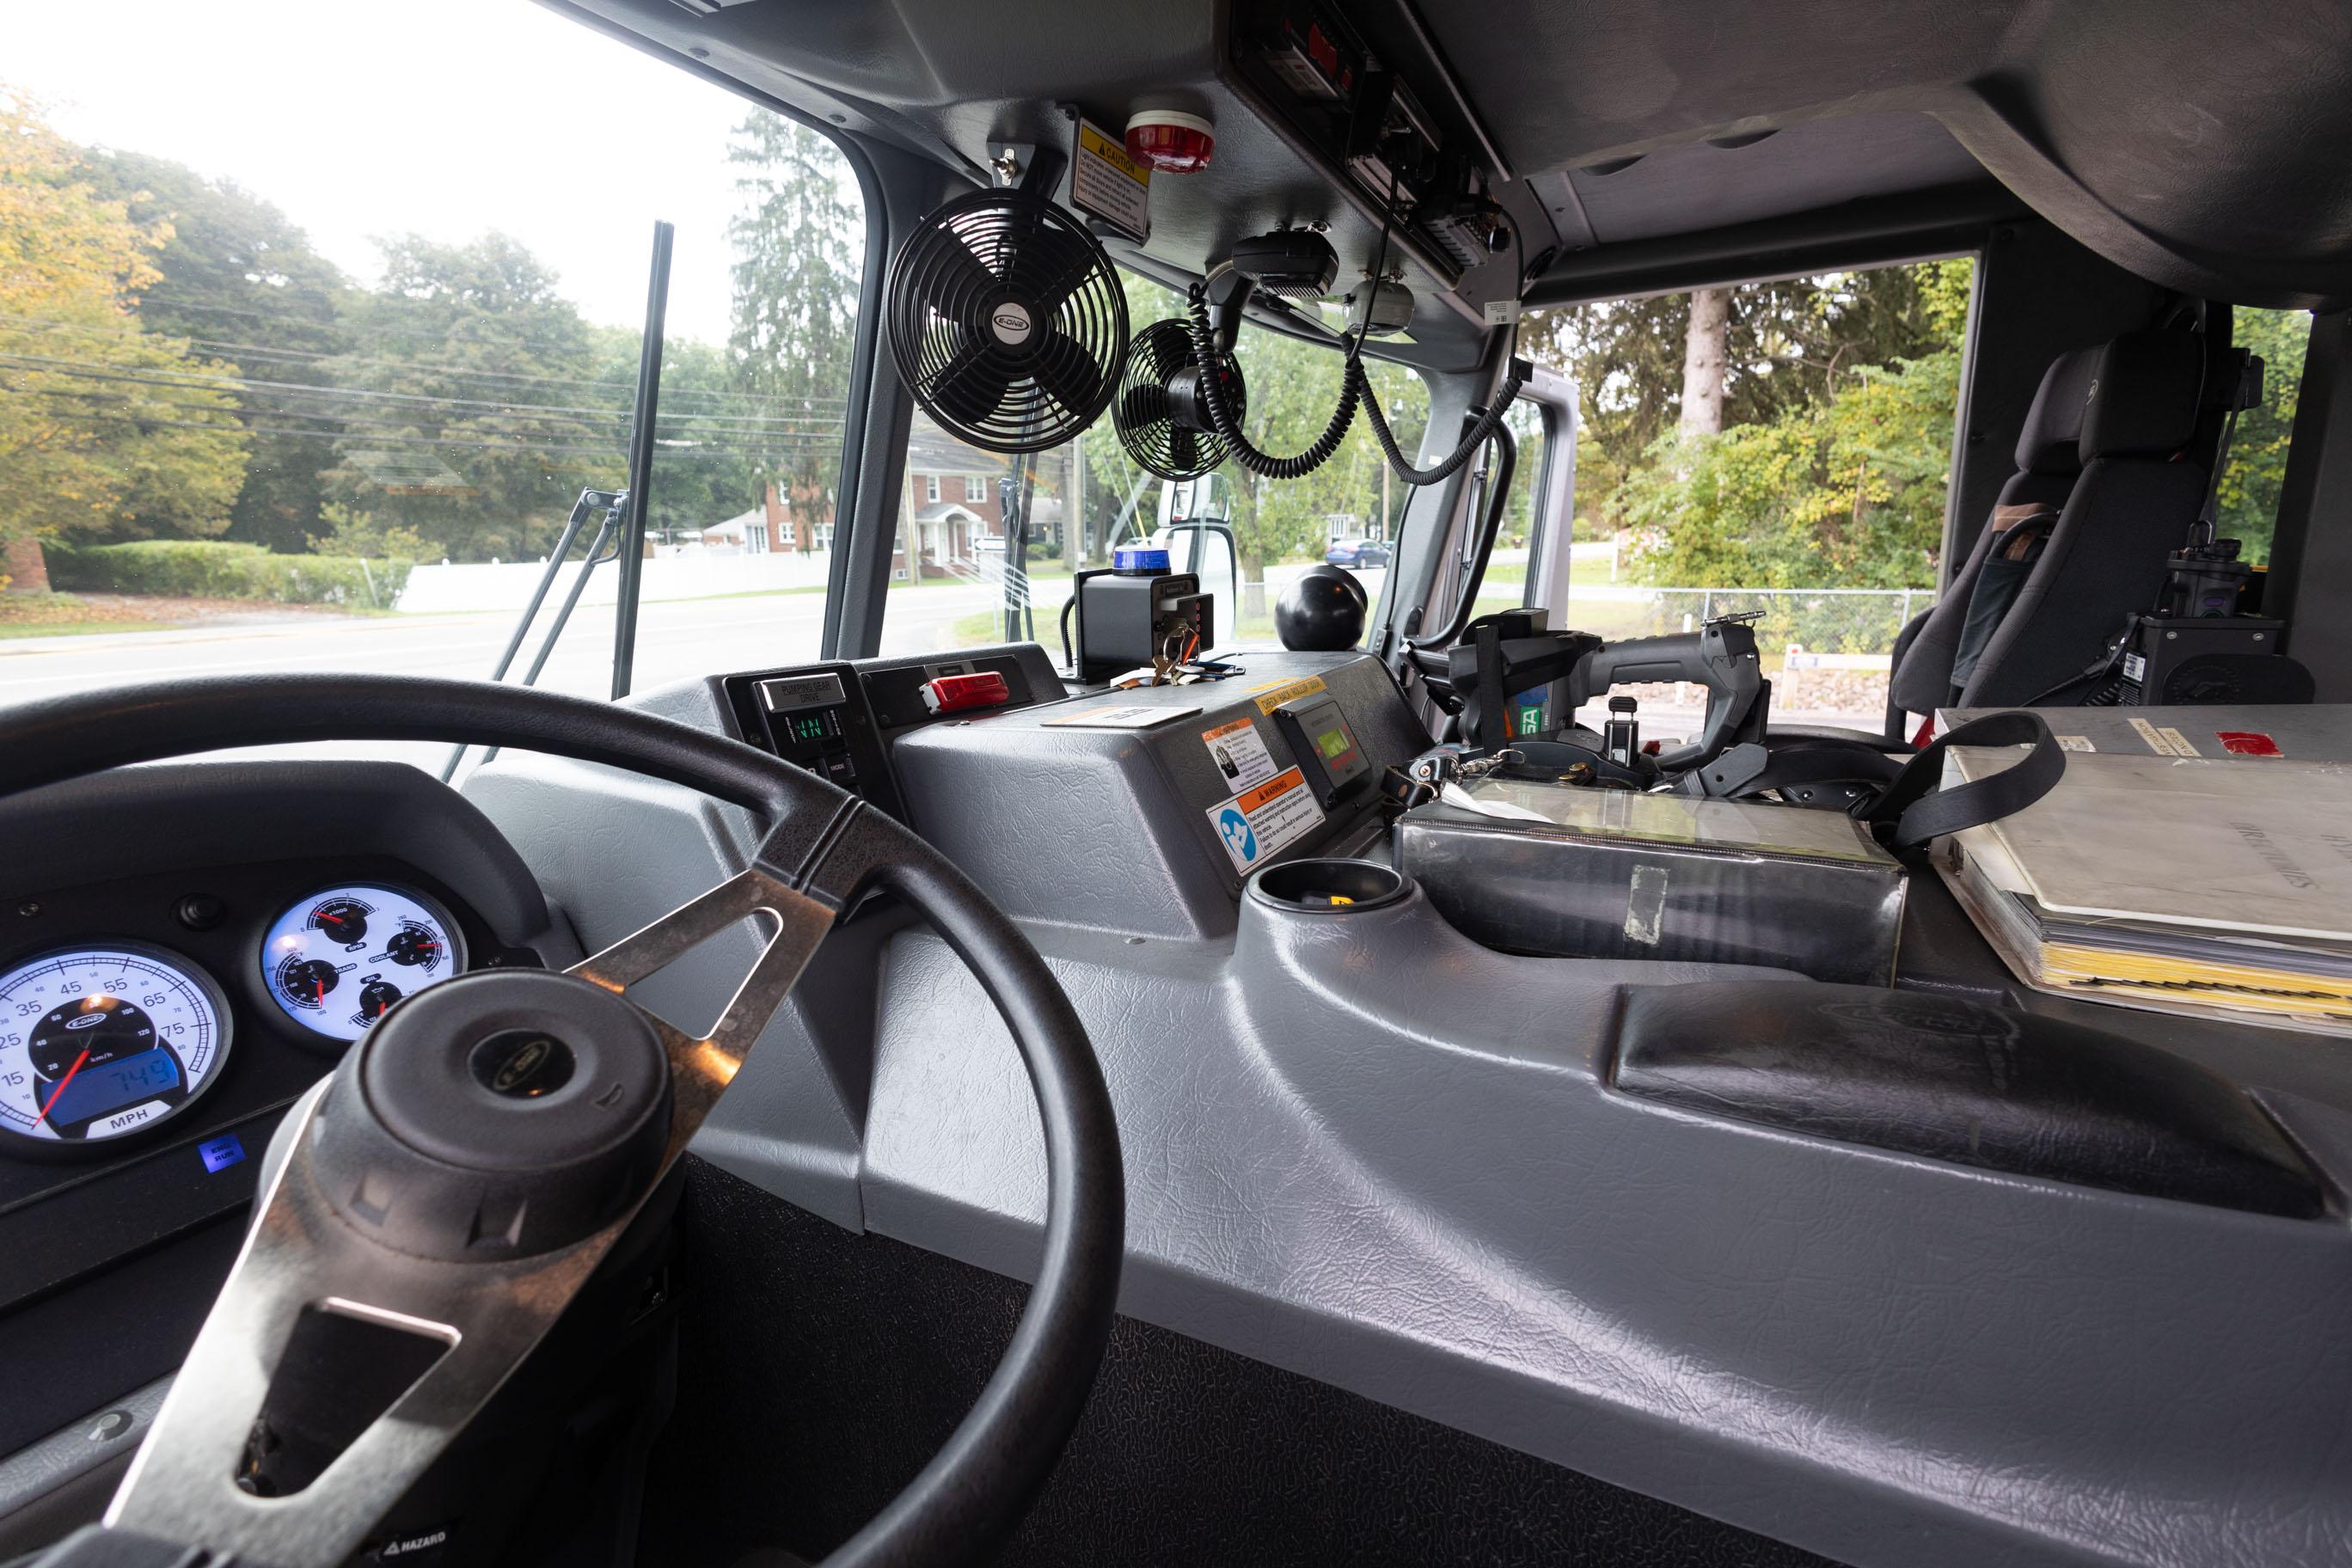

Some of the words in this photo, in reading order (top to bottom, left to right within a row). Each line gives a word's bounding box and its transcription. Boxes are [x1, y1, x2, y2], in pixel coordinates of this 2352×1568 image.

[1106, 148, 1135, 174] CAUTION
[998, 317, 1024, 328] E-ONE
[781, 683, 812, 695] PUMPING
[813, 680, 831, 691] GEAR
[800, 693, 821, 702] DRIVE
[1264, 780, 1288, 798] WARNING
[349, 943, 364, 952] RPM
[370, 950, 399, 963] COOLANT
[334, 964, 357, 974] TRANS
[60, 981, 83, 994] 45
[103, 977, 128, 994] 55
[15, 1000, 42, 1016] 35
[143, 992, 166, 1008] 65
[138, 1028, 150, 1037] 120
[161, 1022, 185, 1038] 75
[0, 1032, 21, 1049] 25
[90, 1051, 113, 1063] km/h
[1, 1071, 25, 1087] 15
[110, 1059, 171, 1092] 749
[110, 1109, 148, 1129] MPH
[215, 1150, 235, 1161] RUN
[401, 1531, 446, 1552] HAZARD
